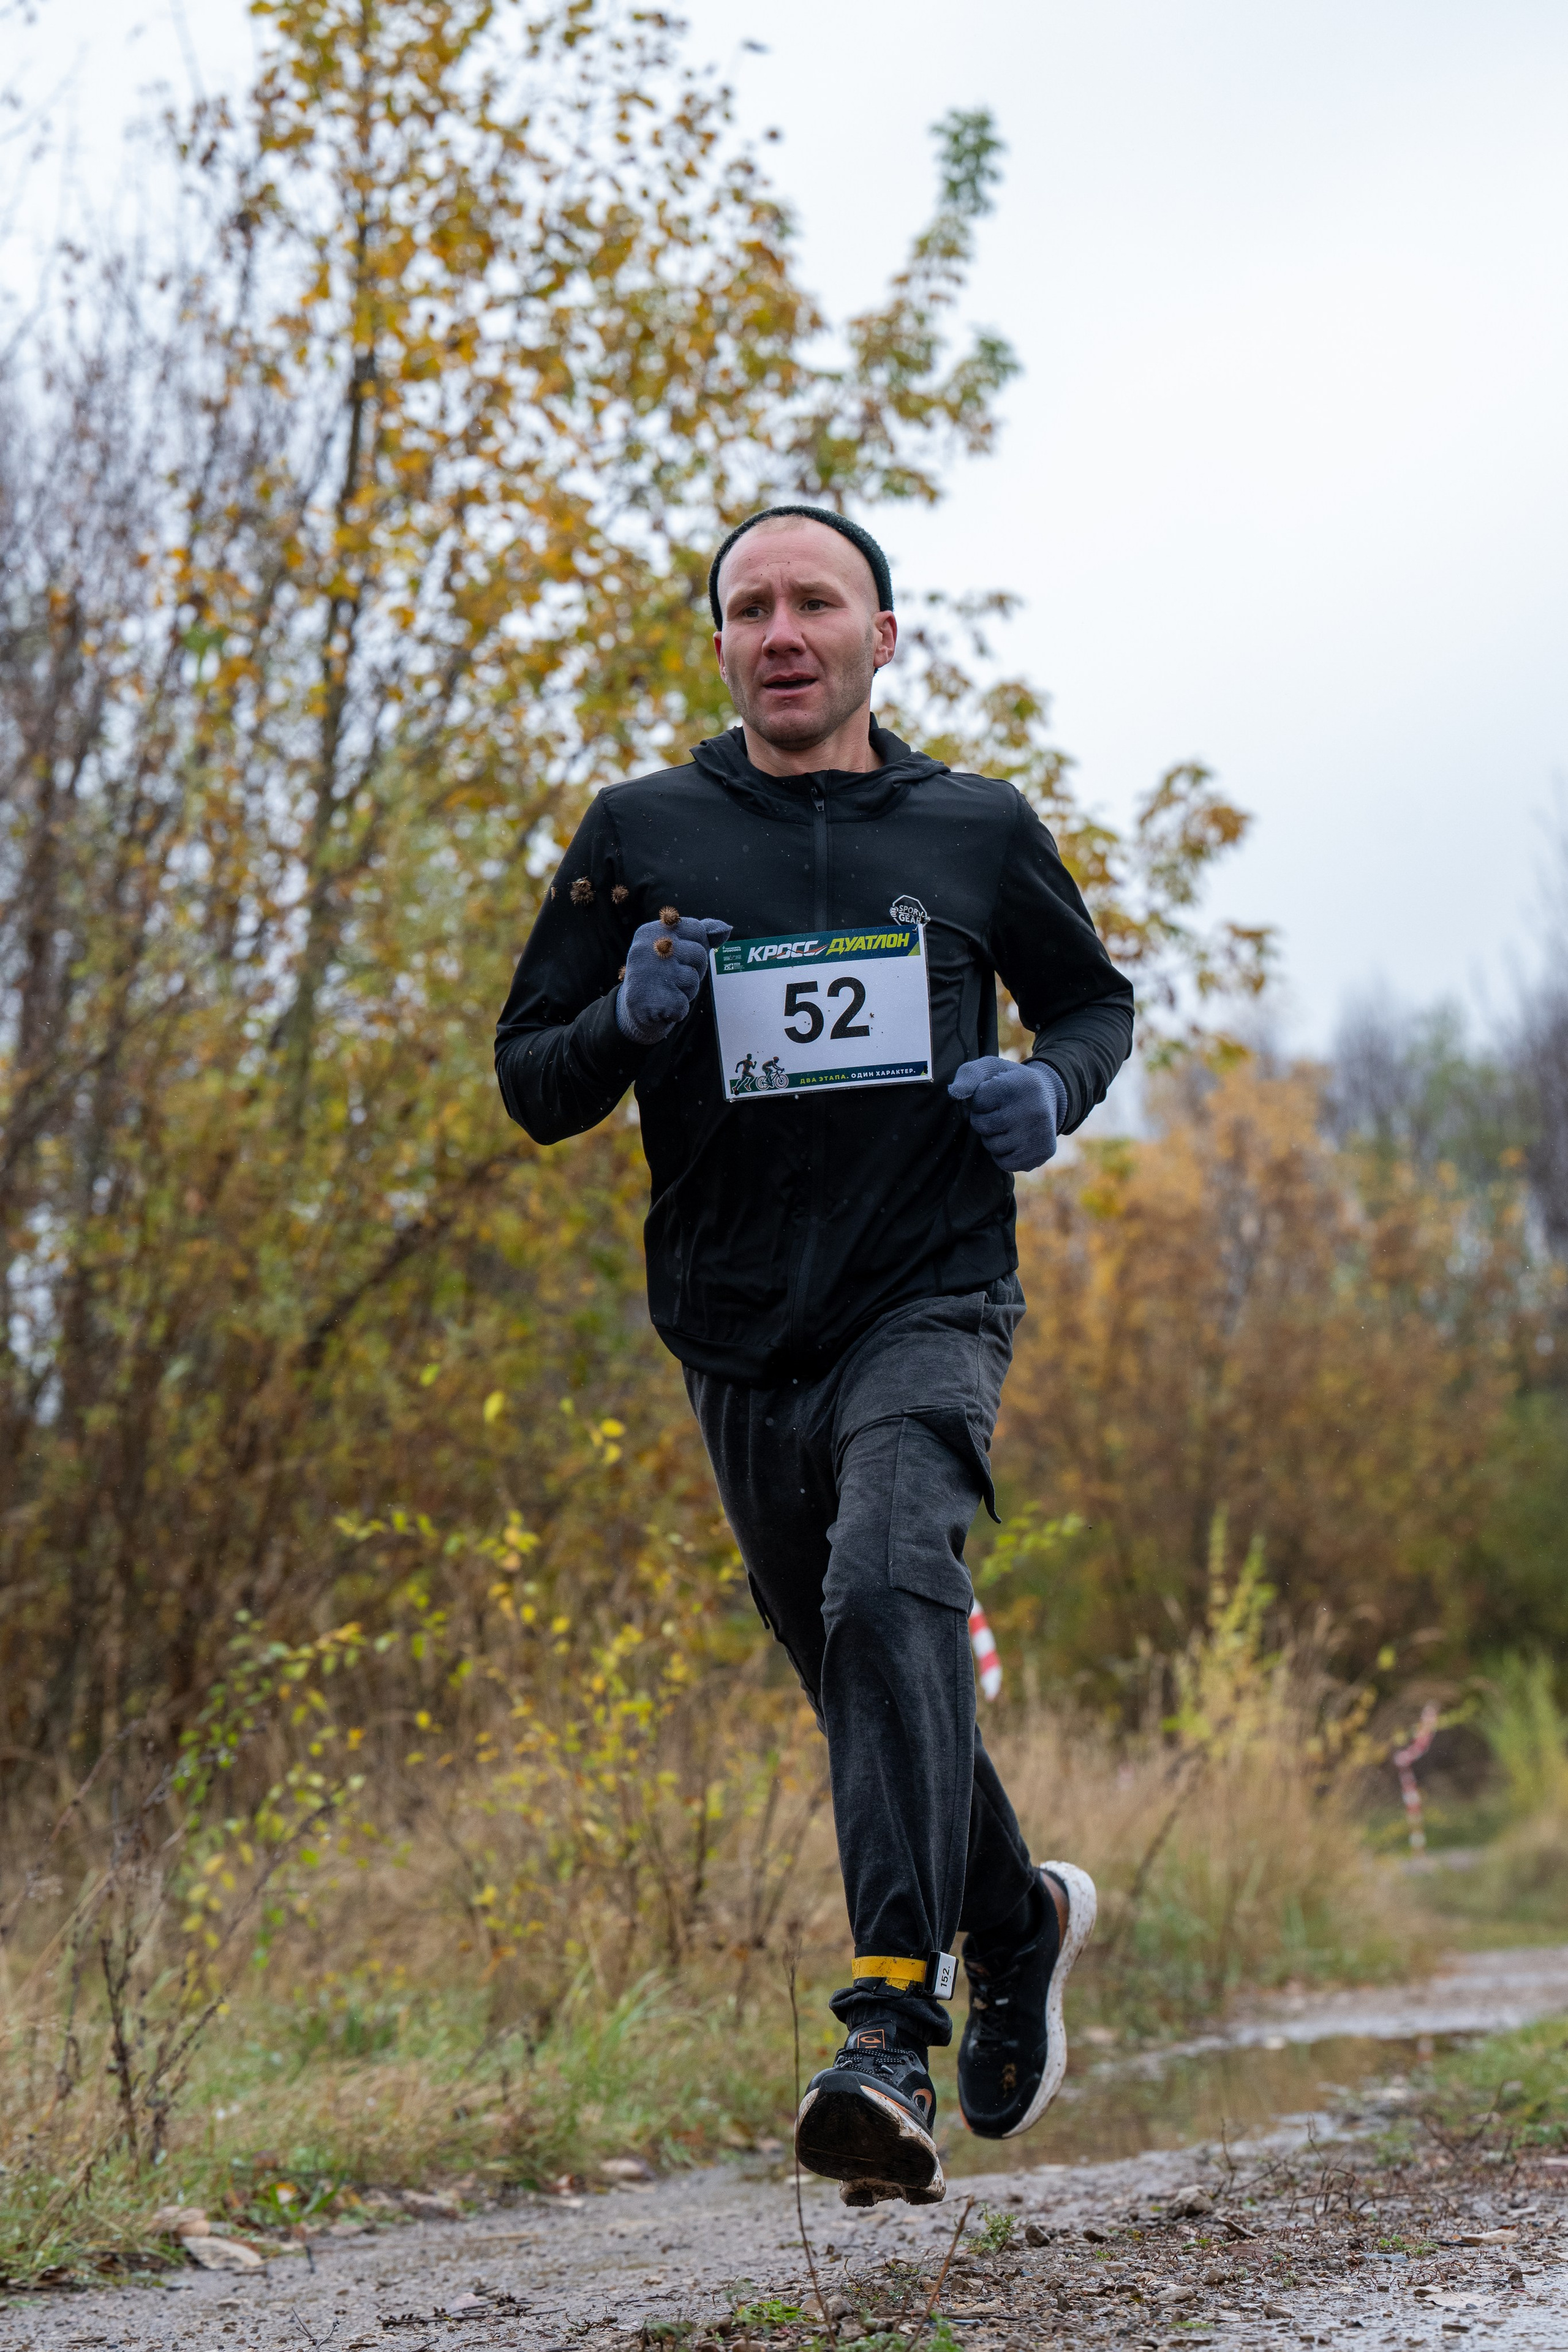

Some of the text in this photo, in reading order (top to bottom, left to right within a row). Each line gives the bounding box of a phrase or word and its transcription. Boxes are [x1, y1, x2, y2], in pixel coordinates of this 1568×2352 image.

[899, 914, 921, 925] GEAR
[747, 933, 910, 963] КРОСС ДУАТЛОН
[784, 976, 870, 1044] 52
[819, 1074, 849, 1083] ЭТАПА.
[875, 1068, 916, 1077] ХАРАКТЕР.
